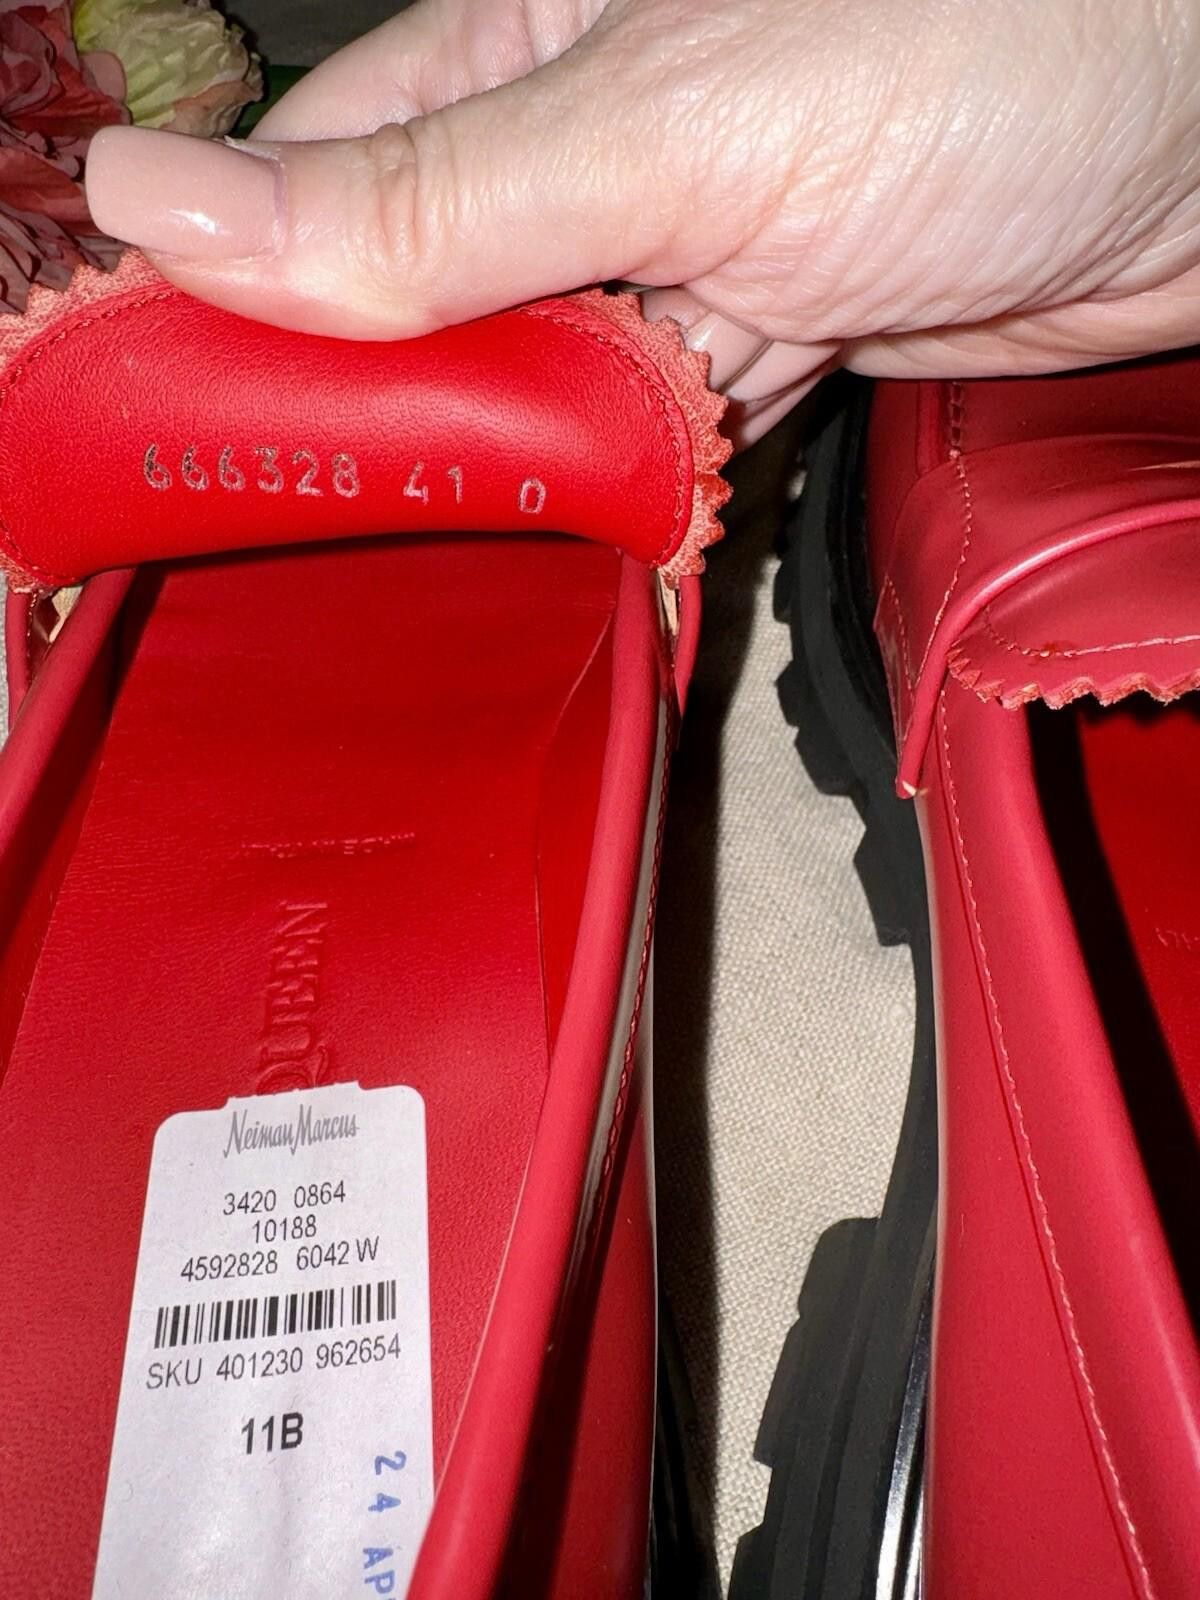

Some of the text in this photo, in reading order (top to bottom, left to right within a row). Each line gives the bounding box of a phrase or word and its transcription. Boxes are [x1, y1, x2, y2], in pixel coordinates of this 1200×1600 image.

[143, 443, 361, 498] 666328
[403, 459, 463, 505] 41
[223, 1103, 360, 1158] Neiman Marcus
[222, 1180, 346, 1216] 3420 0864
[252, 1214, 317, 1243] 10188
[180, 1235, 380, 1282] 4592828 6042 W
[146, 1333, 401, 1390] SKU 401230 962654
[241, 1411, 304, 1455] 11B
[362, 1547, 396, 1600] AP
